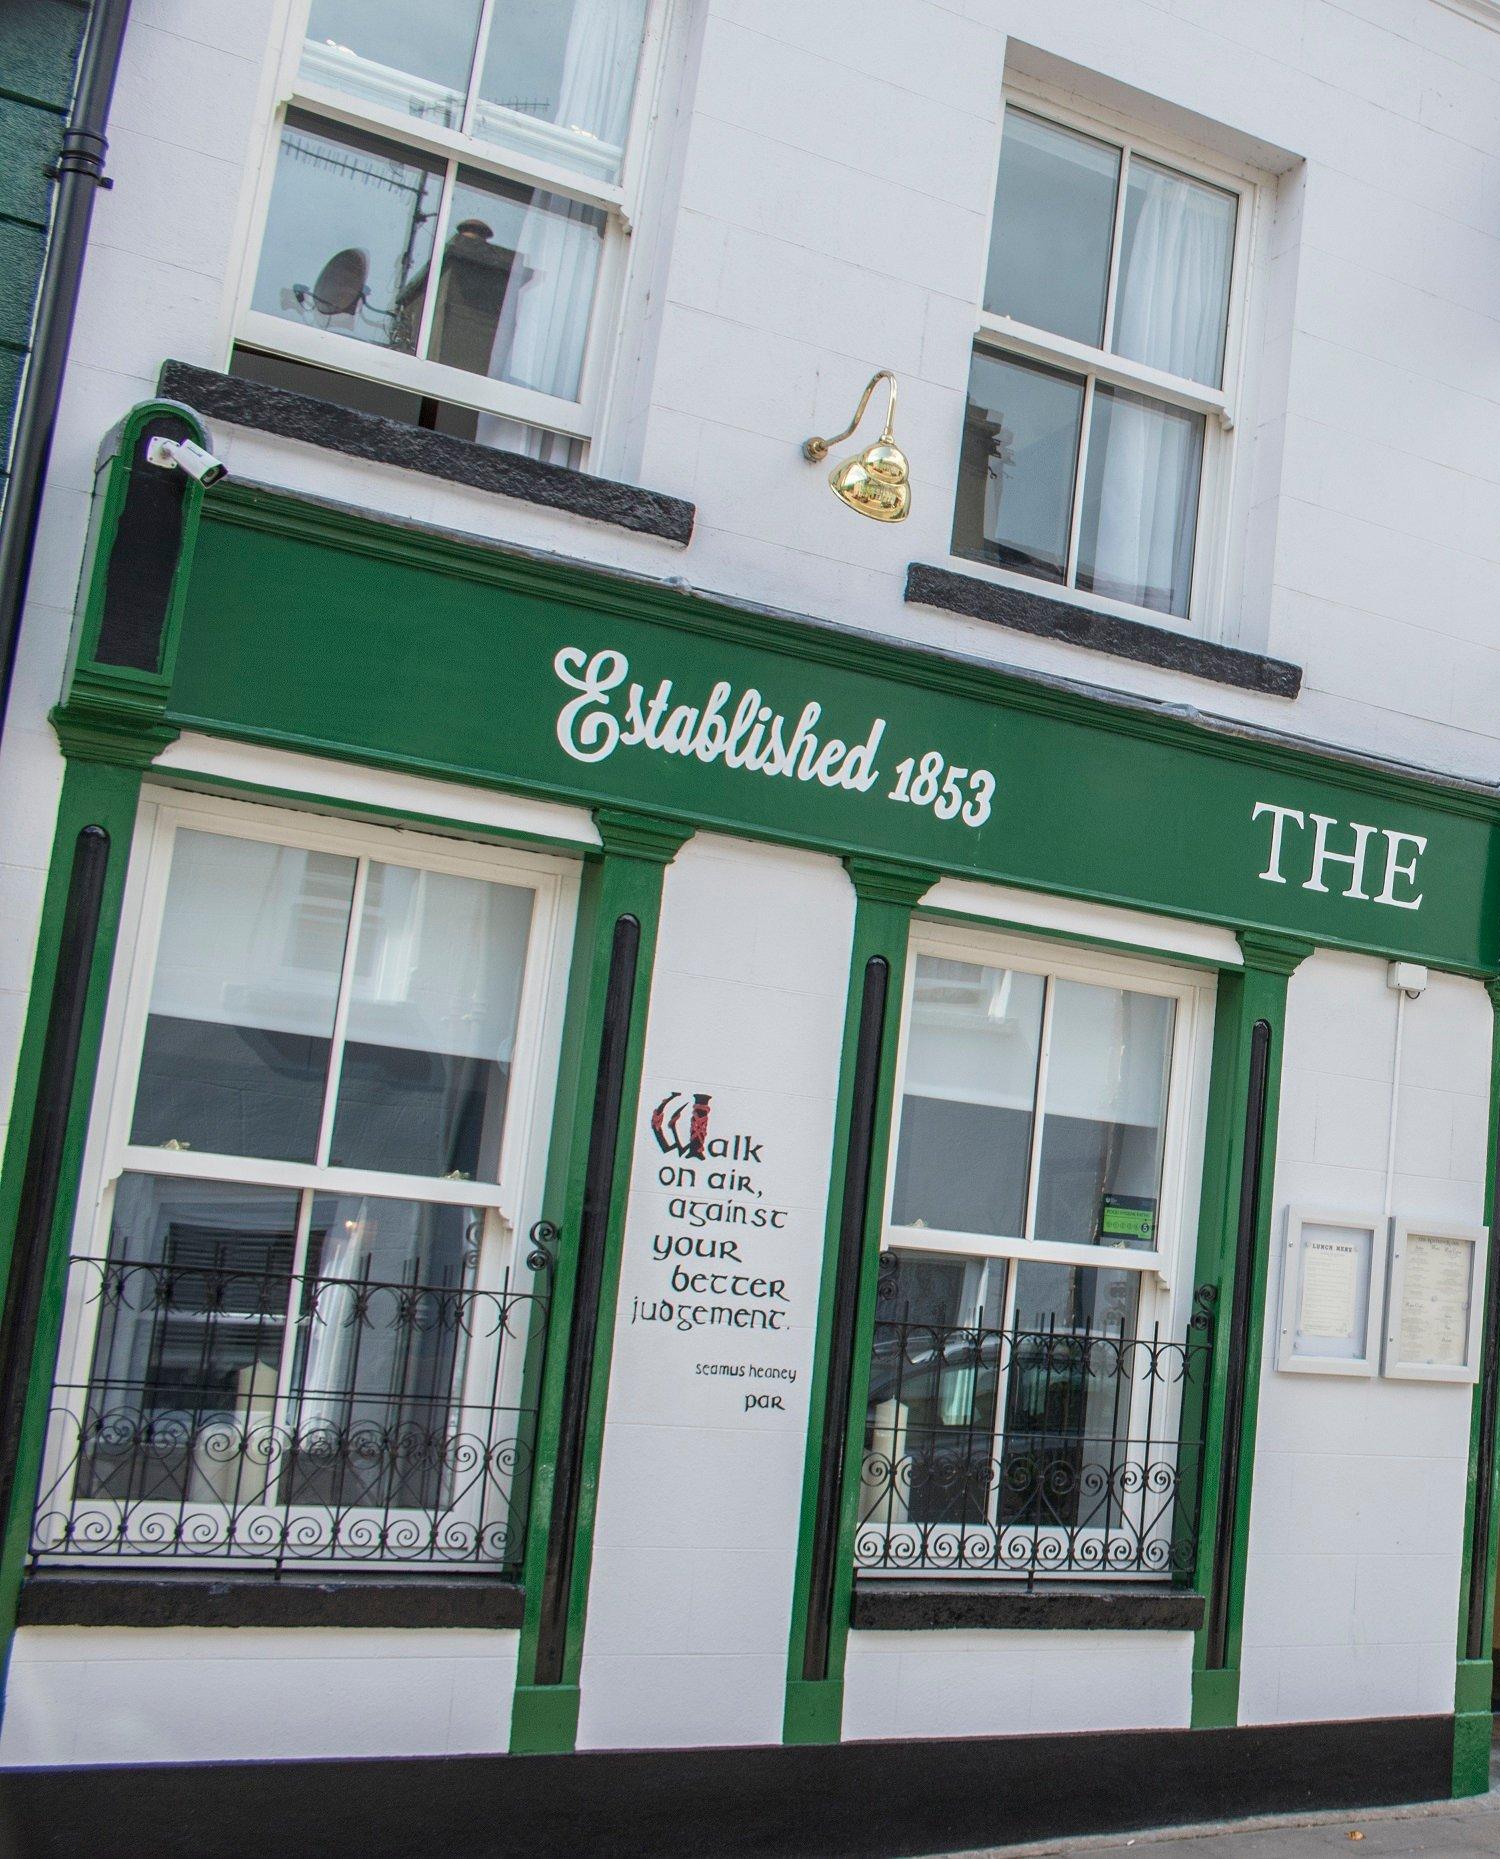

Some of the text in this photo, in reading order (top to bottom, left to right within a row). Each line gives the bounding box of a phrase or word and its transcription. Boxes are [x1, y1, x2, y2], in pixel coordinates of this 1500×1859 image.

[554, 646, 996, 828] Established 1853
[1252, 801, 1428, 910] THE
[652, 1092, 764, 1163] Walk
[659, 1166, 696, 1188] on
[669, 1198, 788, 1229] against
[653, 1234, 742, 1263] your
[672, 1265, 790, 1302] better
